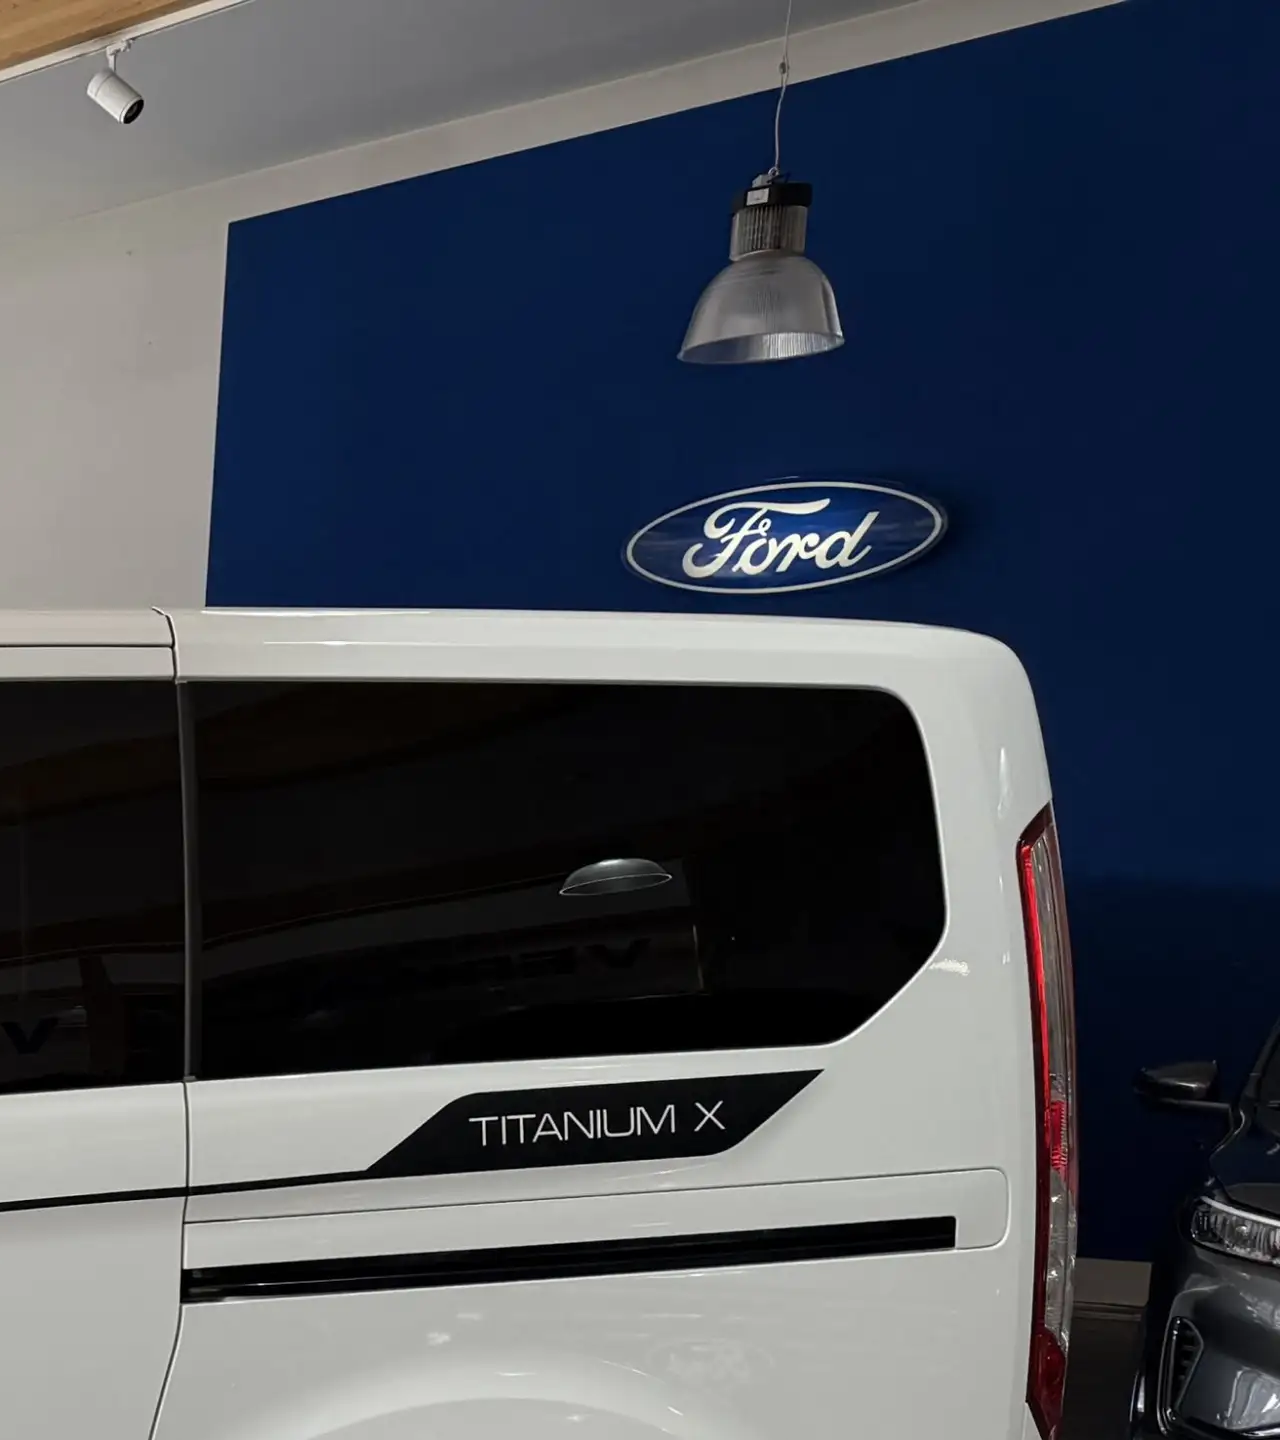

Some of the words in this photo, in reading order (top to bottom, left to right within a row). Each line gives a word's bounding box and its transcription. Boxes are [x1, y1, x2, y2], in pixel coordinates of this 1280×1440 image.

[682, 498, 880, 579] Ford
[468, 1104, 676, 1146] TITANIUM
[693, 1100, 726, 1133] X
